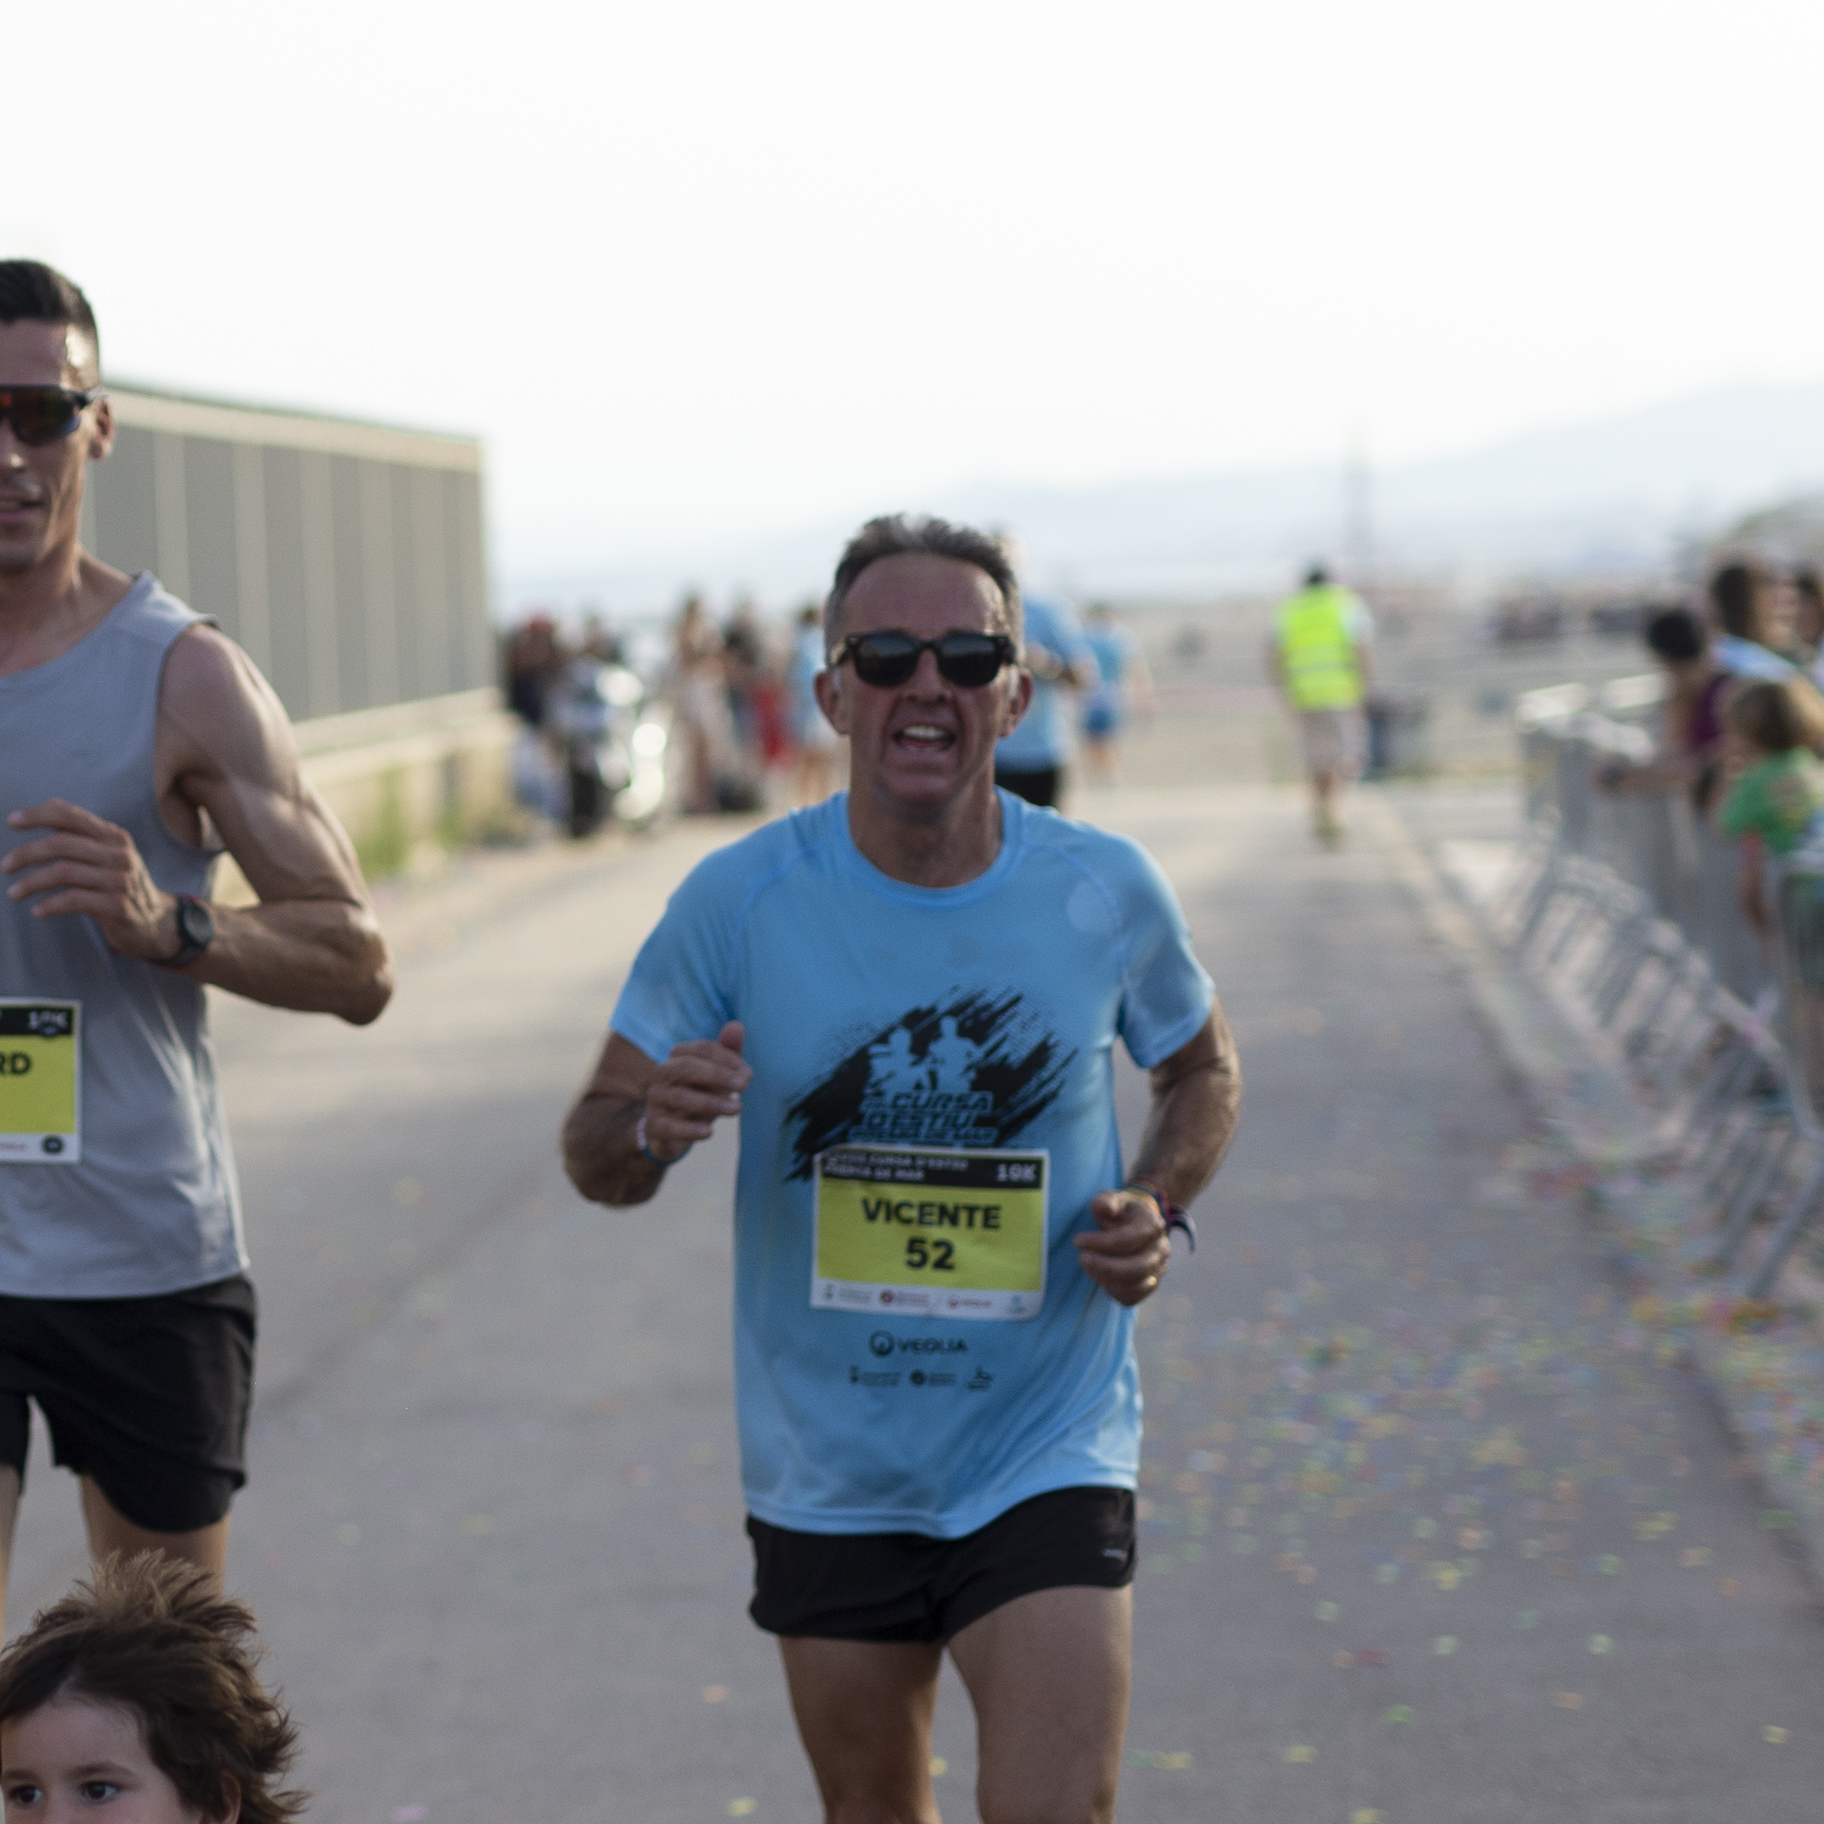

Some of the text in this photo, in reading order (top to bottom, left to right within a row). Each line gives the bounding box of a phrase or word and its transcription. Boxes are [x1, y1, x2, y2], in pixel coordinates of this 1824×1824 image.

[996, 1162, 1037, 1182] 10K
[861, 1197, 1002, 1230] VICENTE
[906, 1237, 956, 1271] 52
